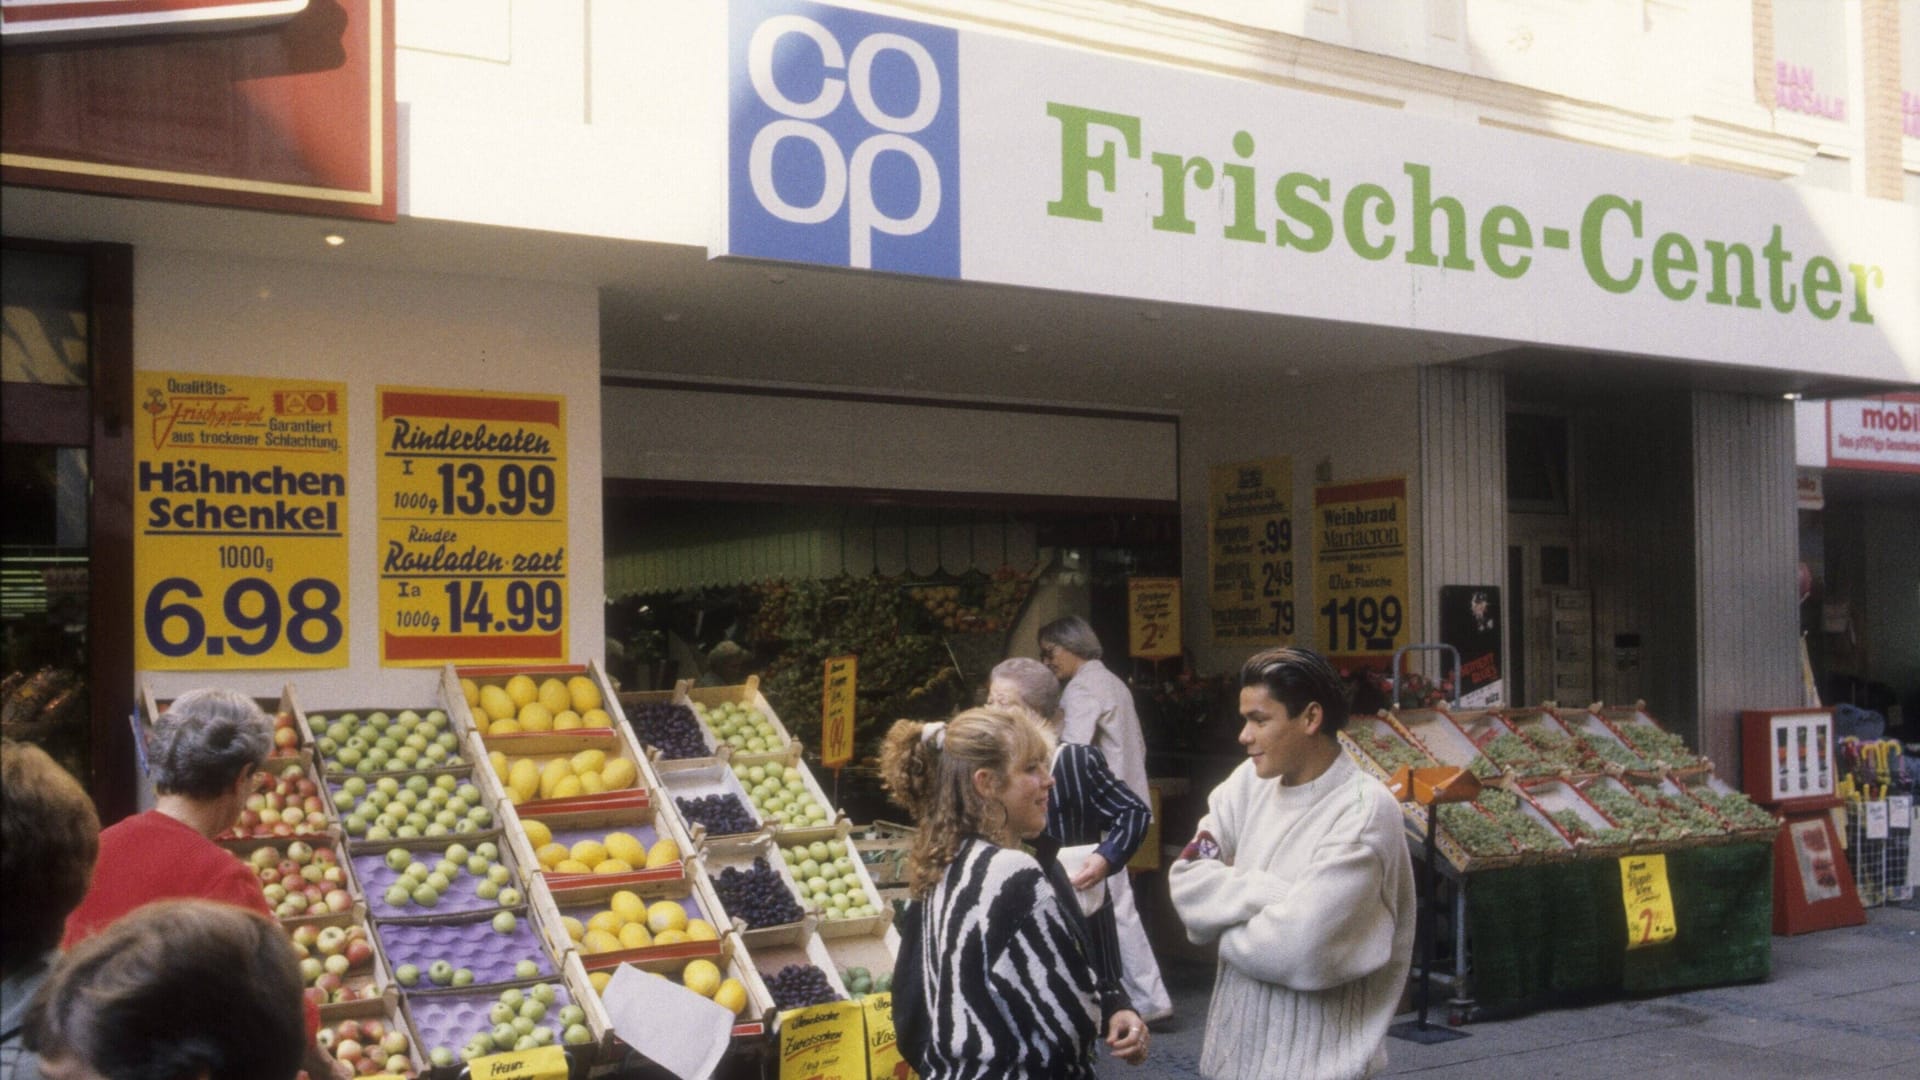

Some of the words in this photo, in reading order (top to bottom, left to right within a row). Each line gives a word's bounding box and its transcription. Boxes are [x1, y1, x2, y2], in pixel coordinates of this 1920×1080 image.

[1047, 101, 1884, 324] Frische-Center
[167, 378, 232, 395] Qualitäts-
[172, 432, 194, 443] aus
[200, 431, 259, 446] trockener
[269, 418, 332, 433] Garantiert
[390, 418, 551, 454] Rinderbraten
[139, 460, 345, 497] Hähnchen
[393, 491, 439, 514] 1000g
[437, 462, 556, 516] 13.99
[148, 498, 338, 530] Schenkel
[1324, 504, 1397, 526] Weinbrand
[408, 525, 458, 544] Rinder
[218, 545, 274, 572] 1000g
[144, 577, 343, 657] 6.98
[396, 610, 440, 632] 1000g
[445, 580, 563, 633] 14.99
